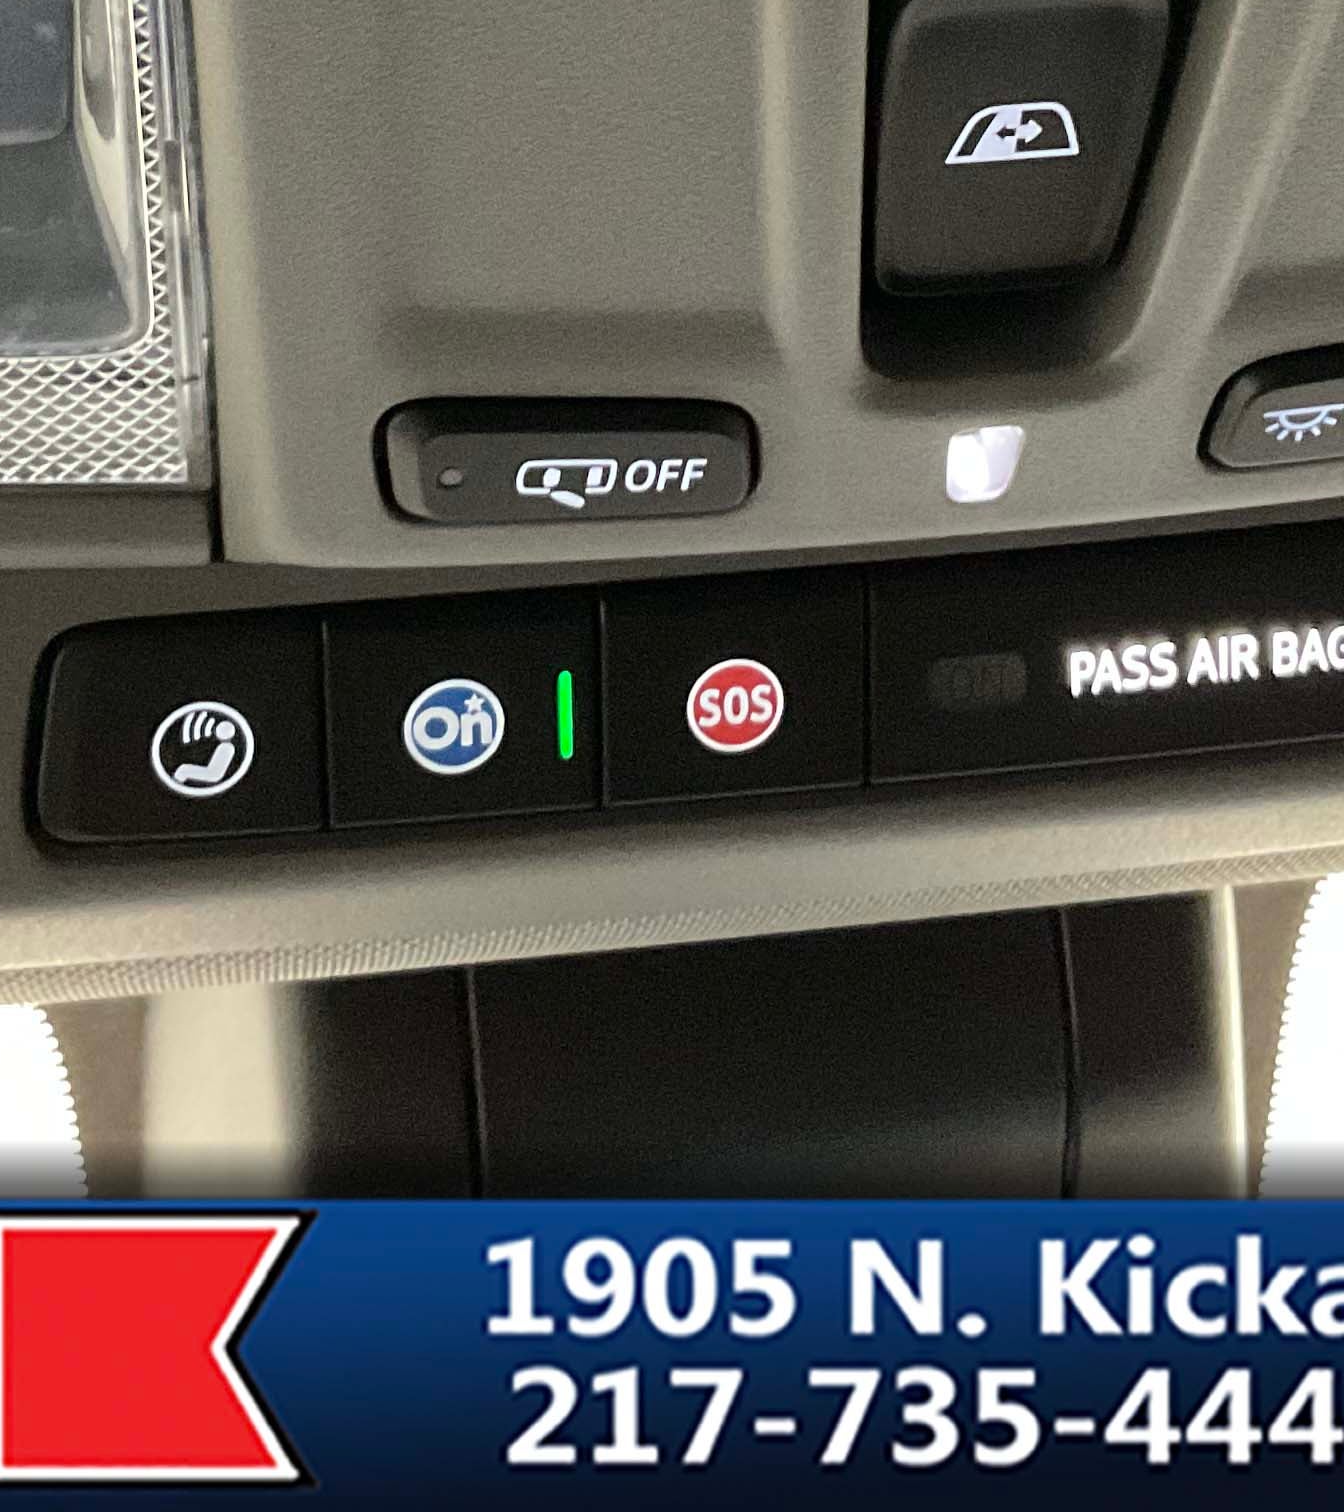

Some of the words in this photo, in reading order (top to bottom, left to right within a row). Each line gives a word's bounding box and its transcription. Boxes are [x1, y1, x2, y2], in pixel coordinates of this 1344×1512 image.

[624, 458, 708, 493] OFF
[1069, 638, 1179, 697] PASS
[1187, 631, 1259, 685] AIR
[698, 683, 773, 728] SOS
